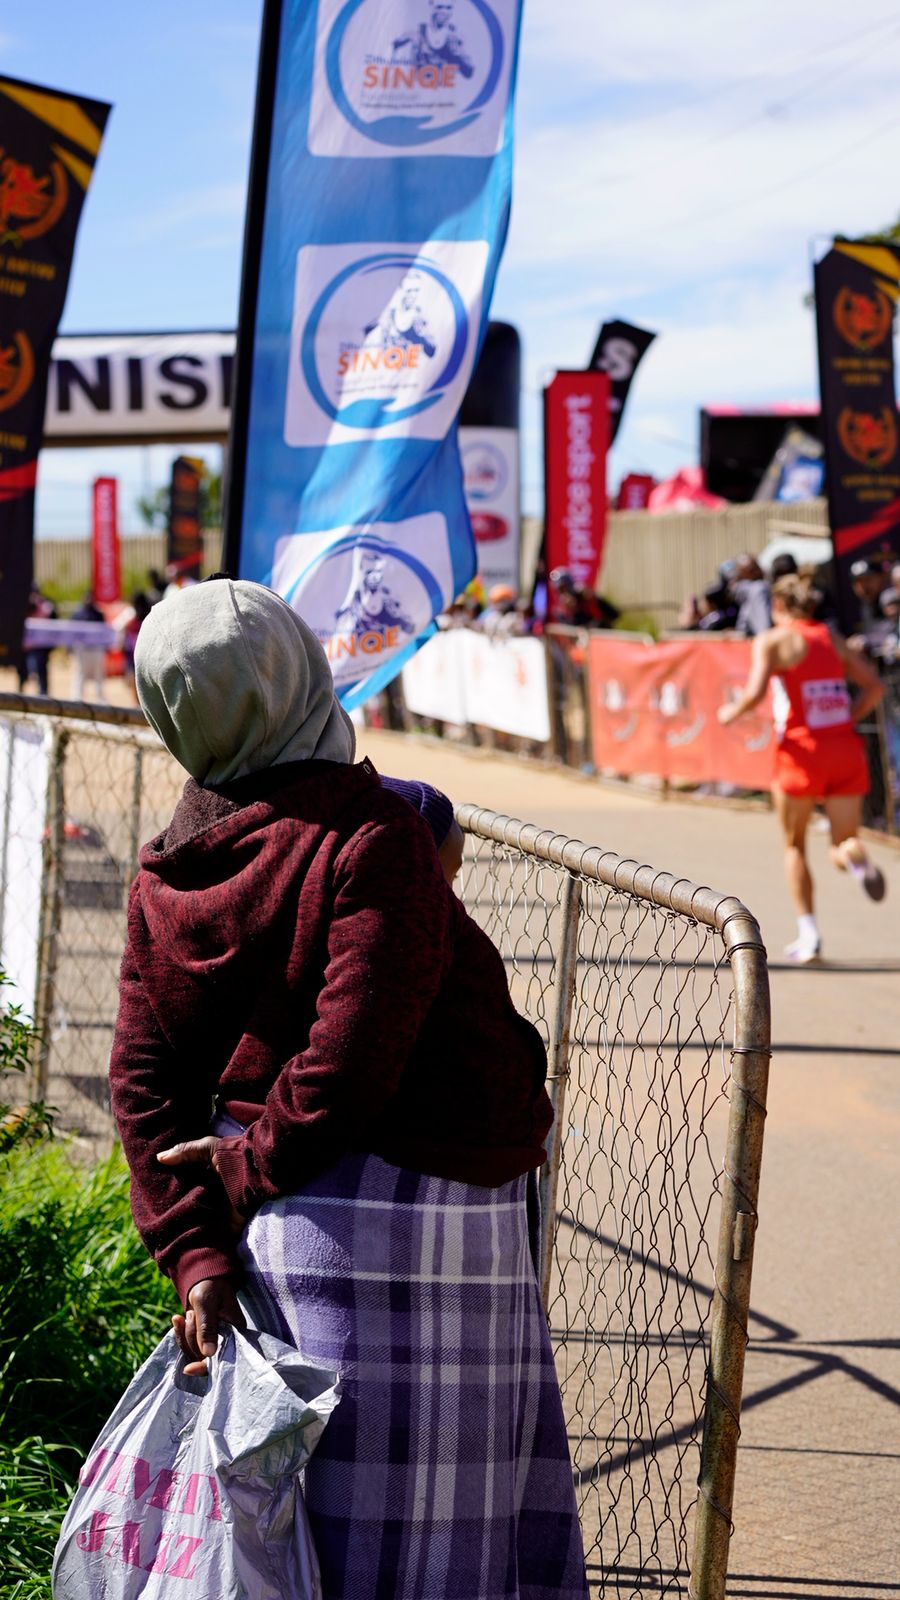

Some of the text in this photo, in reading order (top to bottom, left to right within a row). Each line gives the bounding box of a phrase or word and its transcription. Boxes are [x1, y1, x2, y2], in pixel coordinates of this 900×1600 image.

[363, 64, 458, 90] SINQE
[336, 344, 421, 377] SINQE
[564, 394, 595, 479] sport
[320, 625, 401, 661] INQE
